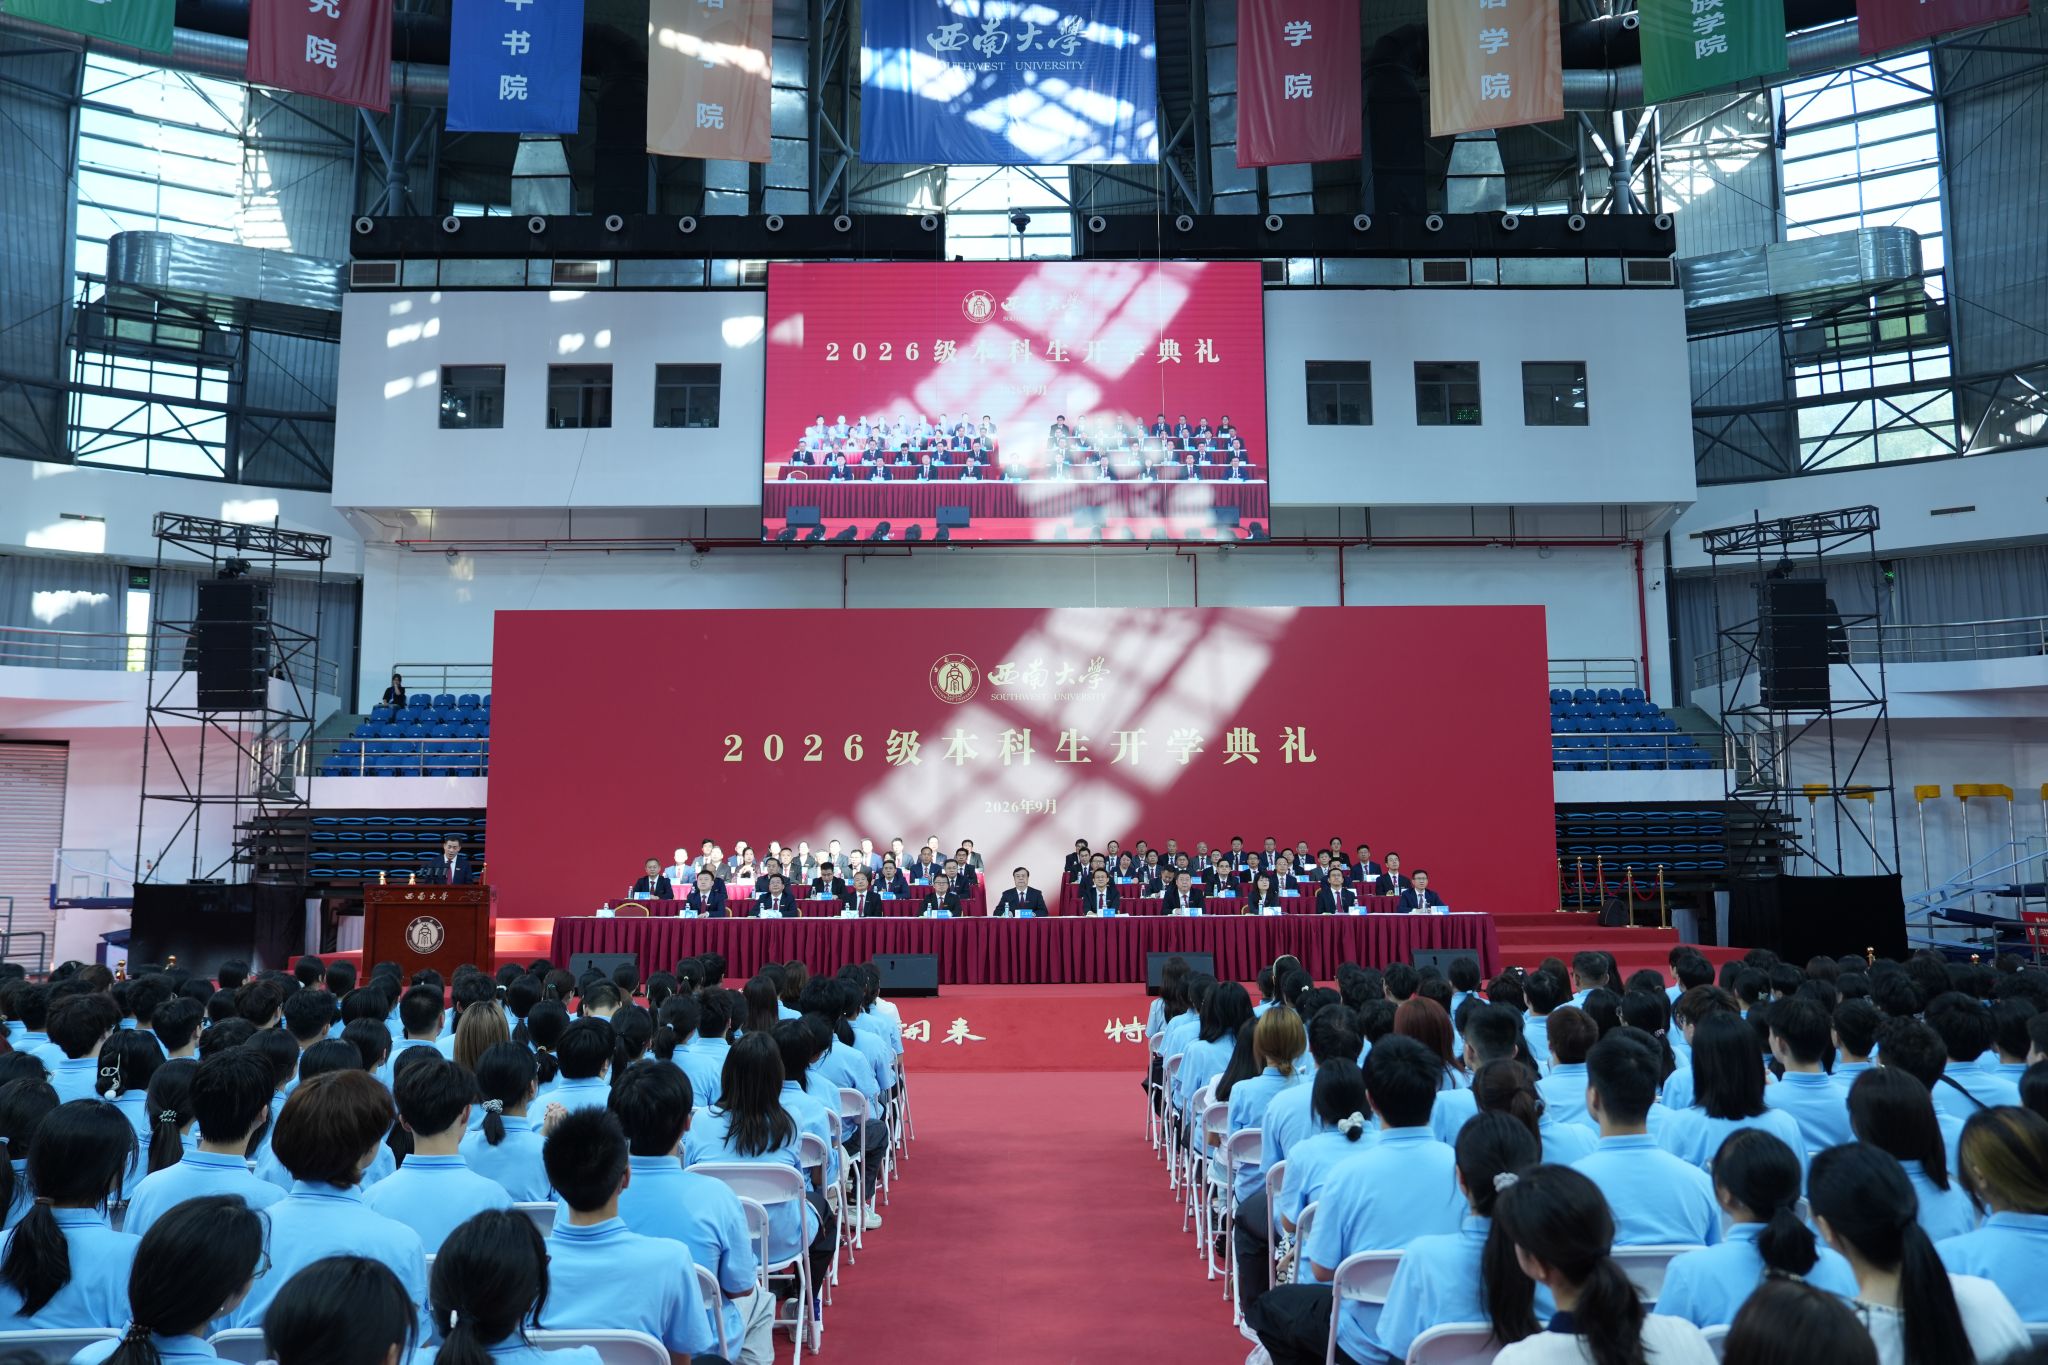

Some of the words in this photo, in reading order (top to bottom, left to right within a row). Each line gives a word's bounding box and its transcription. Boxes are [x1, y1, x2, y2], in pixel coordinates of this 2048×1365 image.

[1015, 60, 1085, 71] UNIVERSITY
[1284, 20, 1313, 100] 学院
[724, 725, 1317, 766] 2026级本科生开学典礼
[984, 798, 1057, 815] 2026年9月
